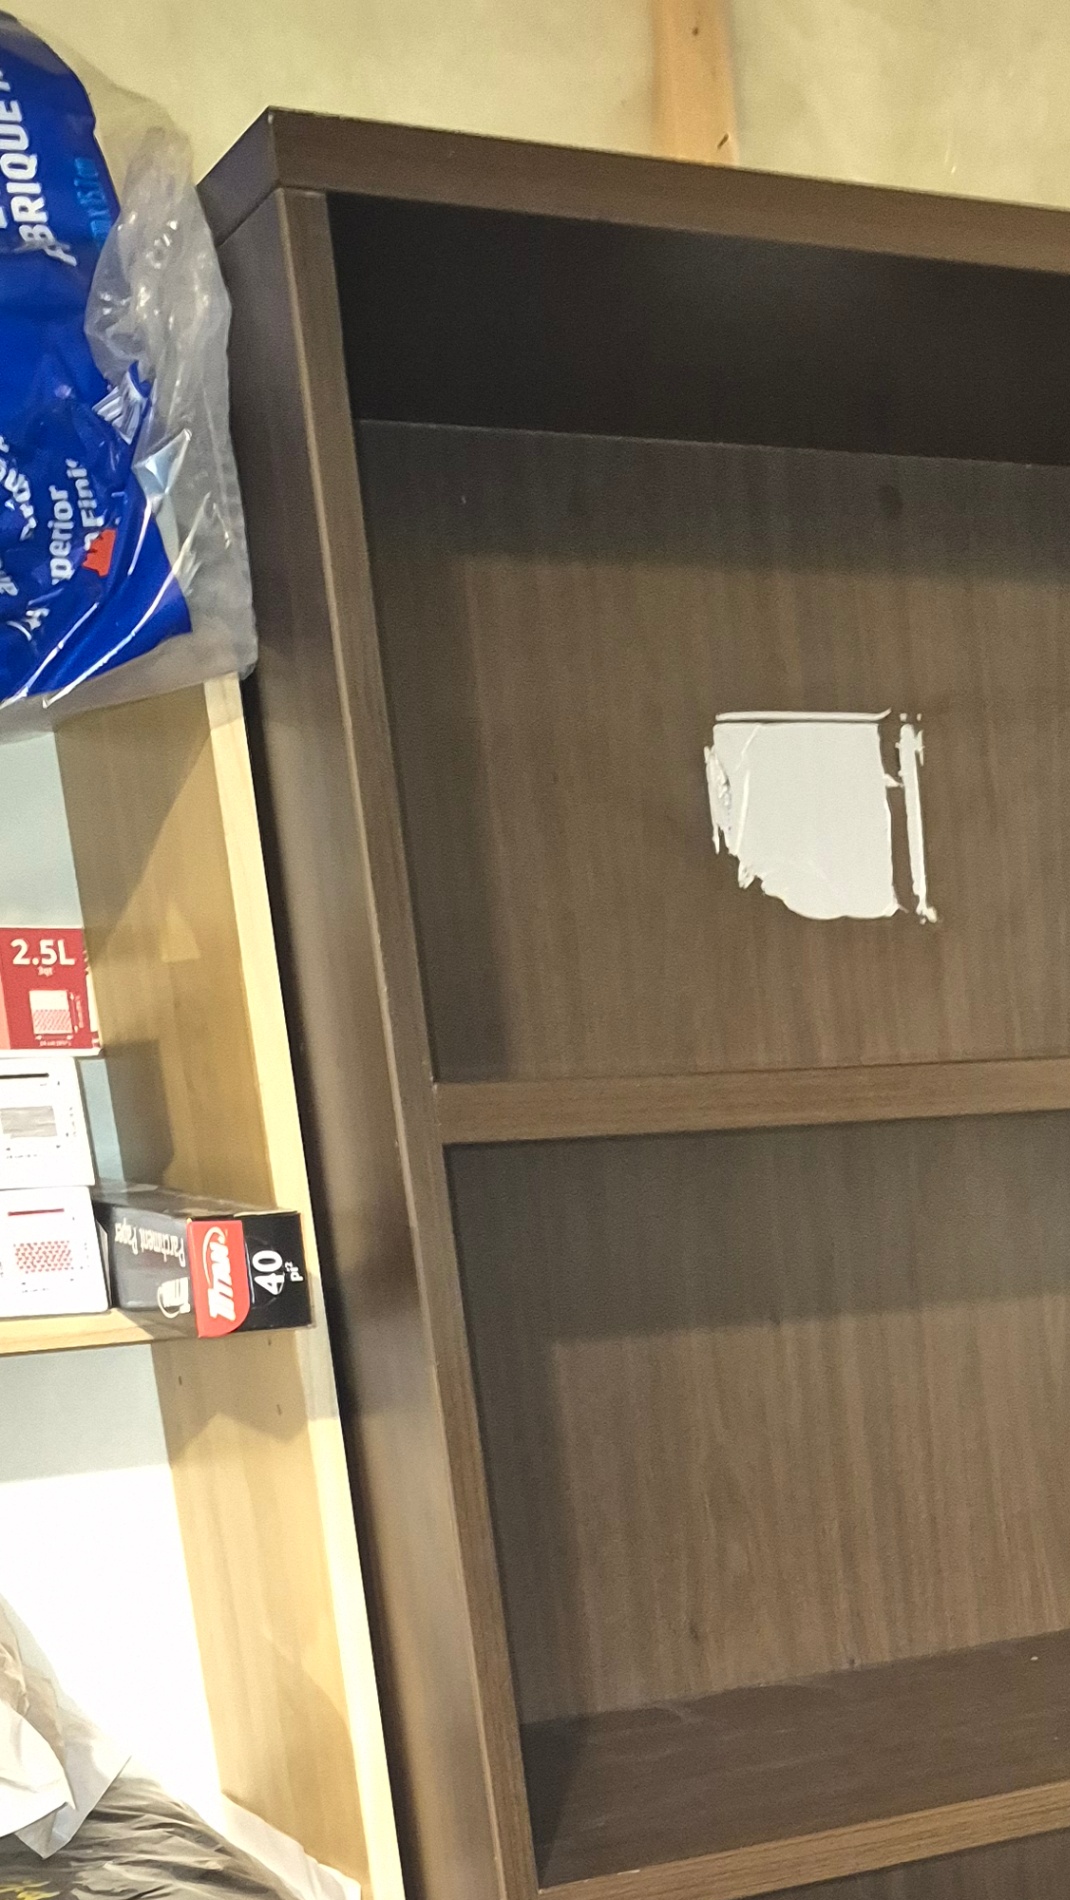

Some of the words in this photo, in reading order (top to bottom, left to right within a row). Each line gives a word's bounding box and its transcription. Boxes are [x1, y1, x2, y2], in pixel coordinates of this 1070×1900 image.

[48, 484, 75, 586] perior
[10, 938, 76, 966] 2.5L
[114, 1217, 139, 1255] Paper
[139, 1226, 187, 1268] Parchment
[252, 1249, 286, 1296] 40
